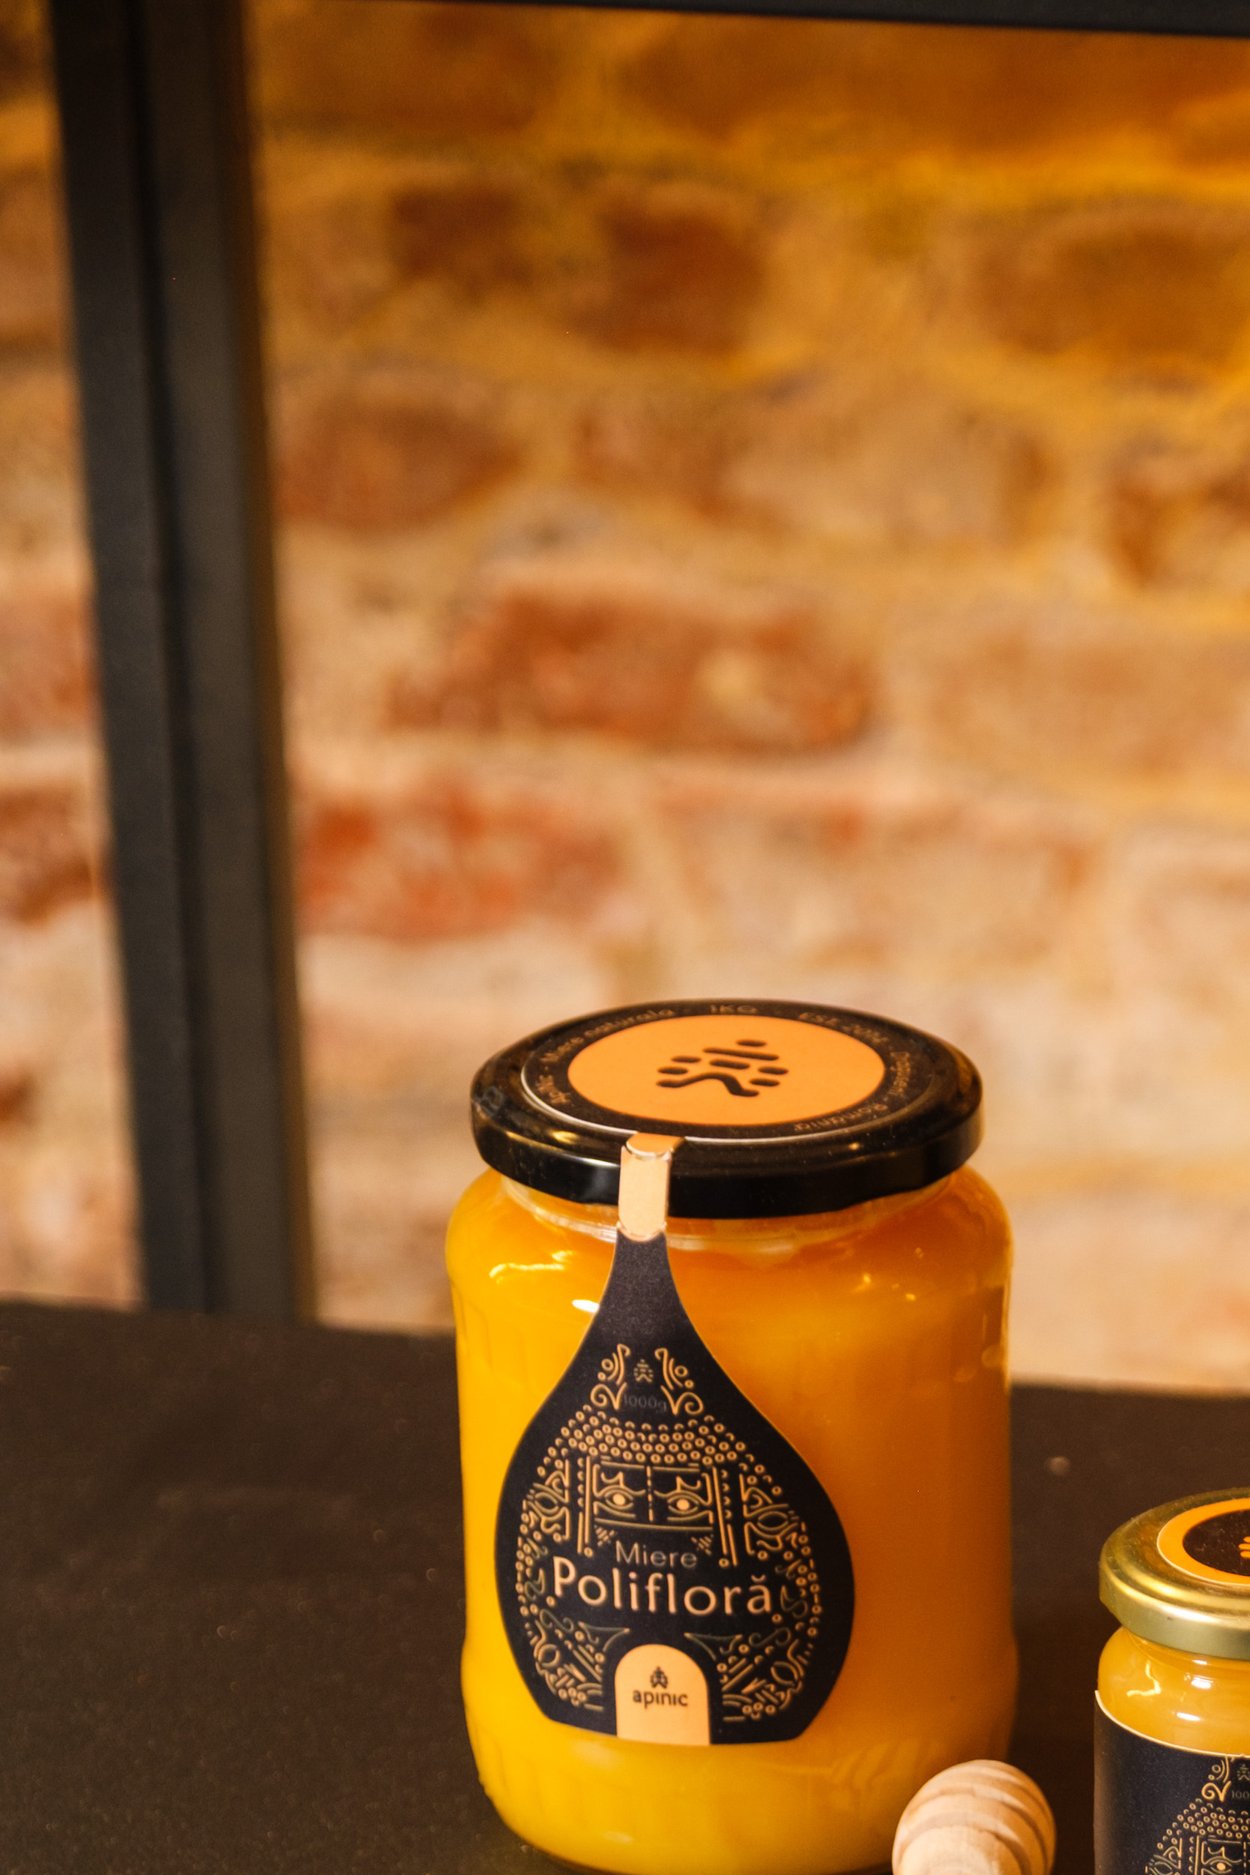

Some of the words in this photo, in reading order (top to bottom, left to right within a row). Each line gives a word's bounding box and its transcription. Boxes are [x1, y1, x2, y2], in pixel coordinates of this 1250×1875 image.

[614, 1539, 699, 1569] Miere
[552, 1555, 773, 1617] Polifloră
[632, 1686, 690, 1711] apinic
